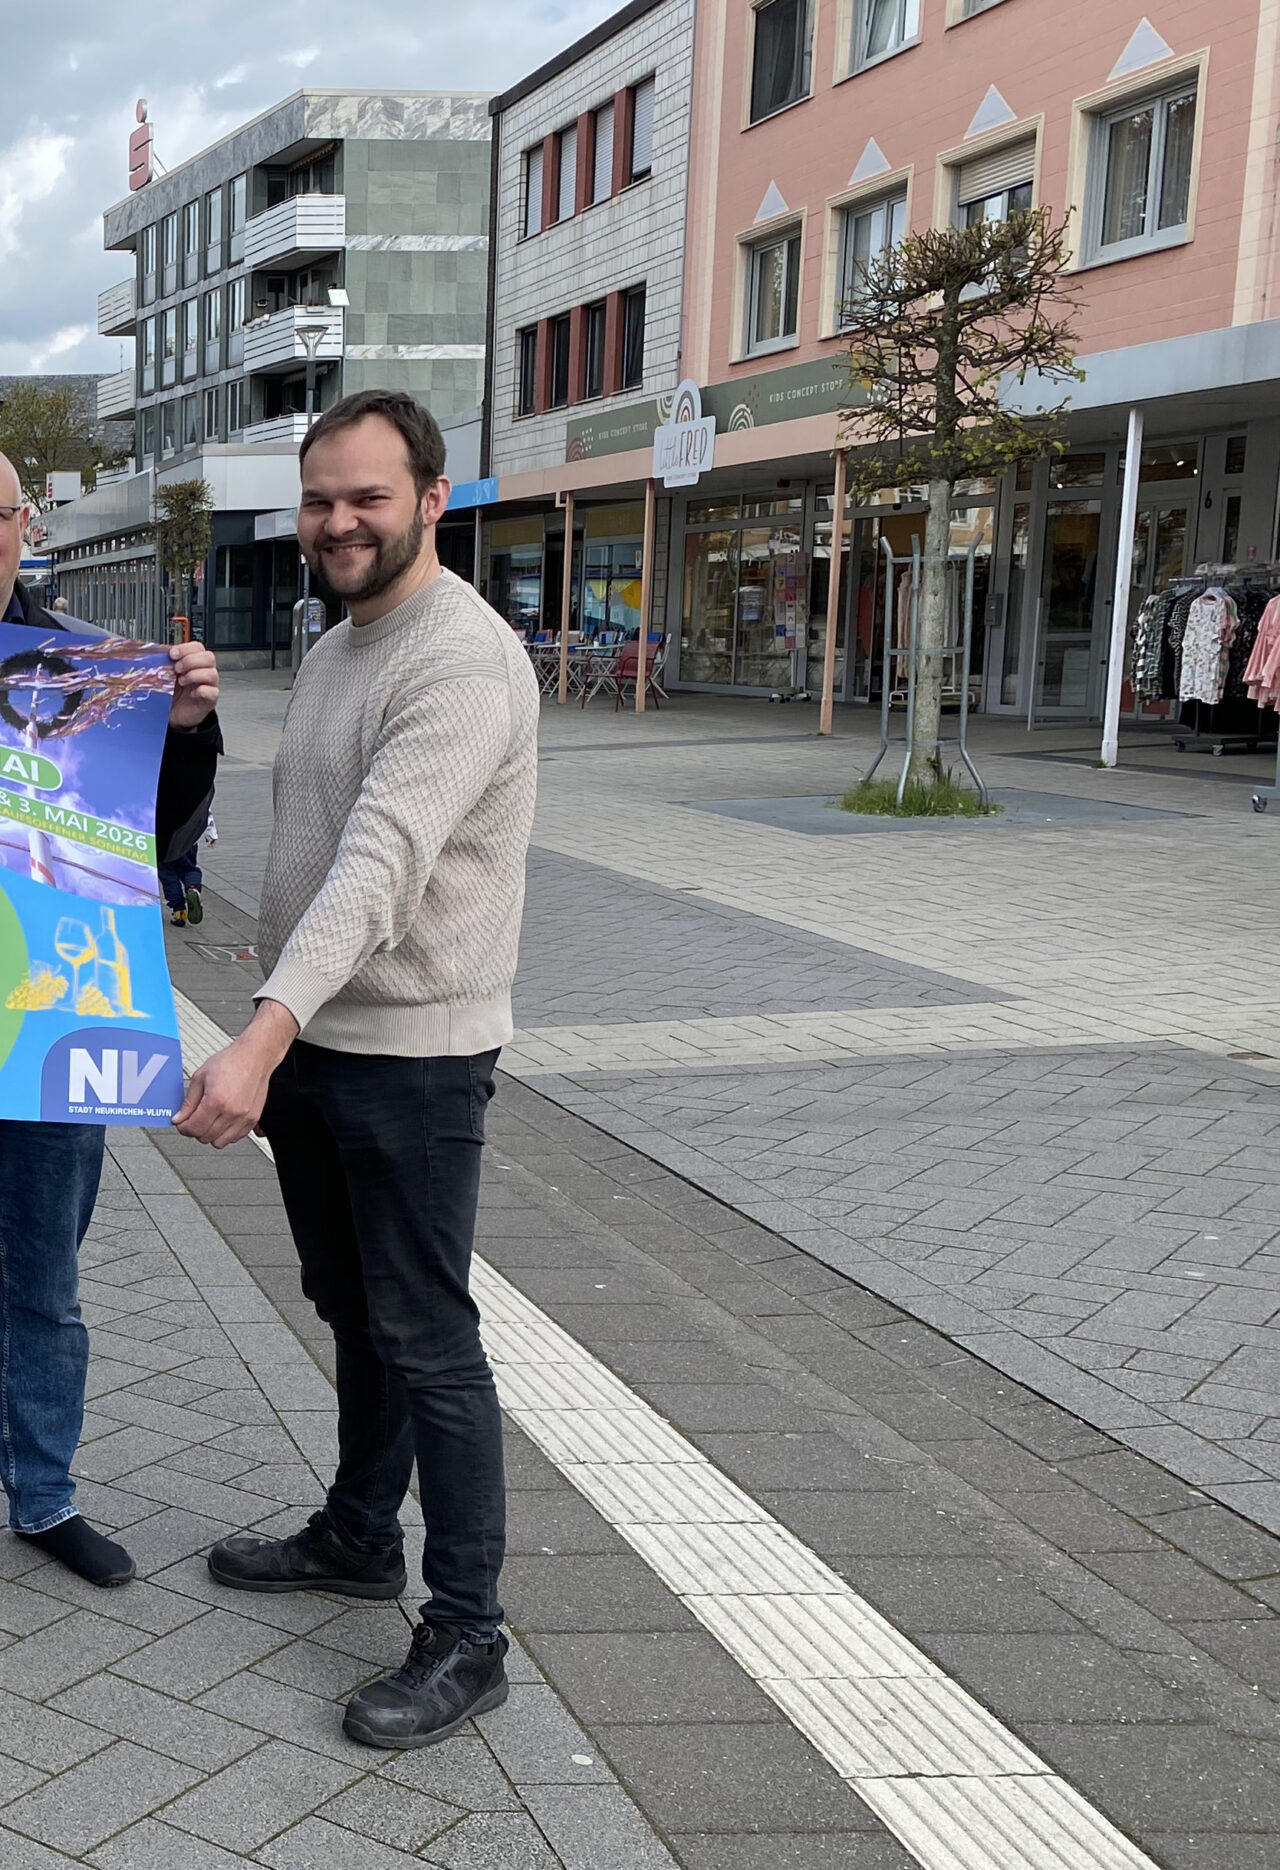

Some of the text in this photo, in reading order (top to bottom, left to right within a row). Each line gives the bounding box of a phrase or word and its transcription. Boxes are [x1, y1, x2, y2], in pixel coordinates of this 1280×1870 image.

[769, 392, 784, 403] KIDS
[786, 384, 819, 400] CONCEPT
[679, 427, 708, 468] FRED
[1204, 490, 1212, 509] 6
[18, 798, 37, 816] 3.
[44, 806, 89, 833] MAI
[95, 821, 148, 851] 2026
[89, 835, 149, 864] SONNTAG
[68, 1048, 170, 1105] NV
[68, 1105, 173, 1118] STADT NEUKIRCHEN-VLUYN
